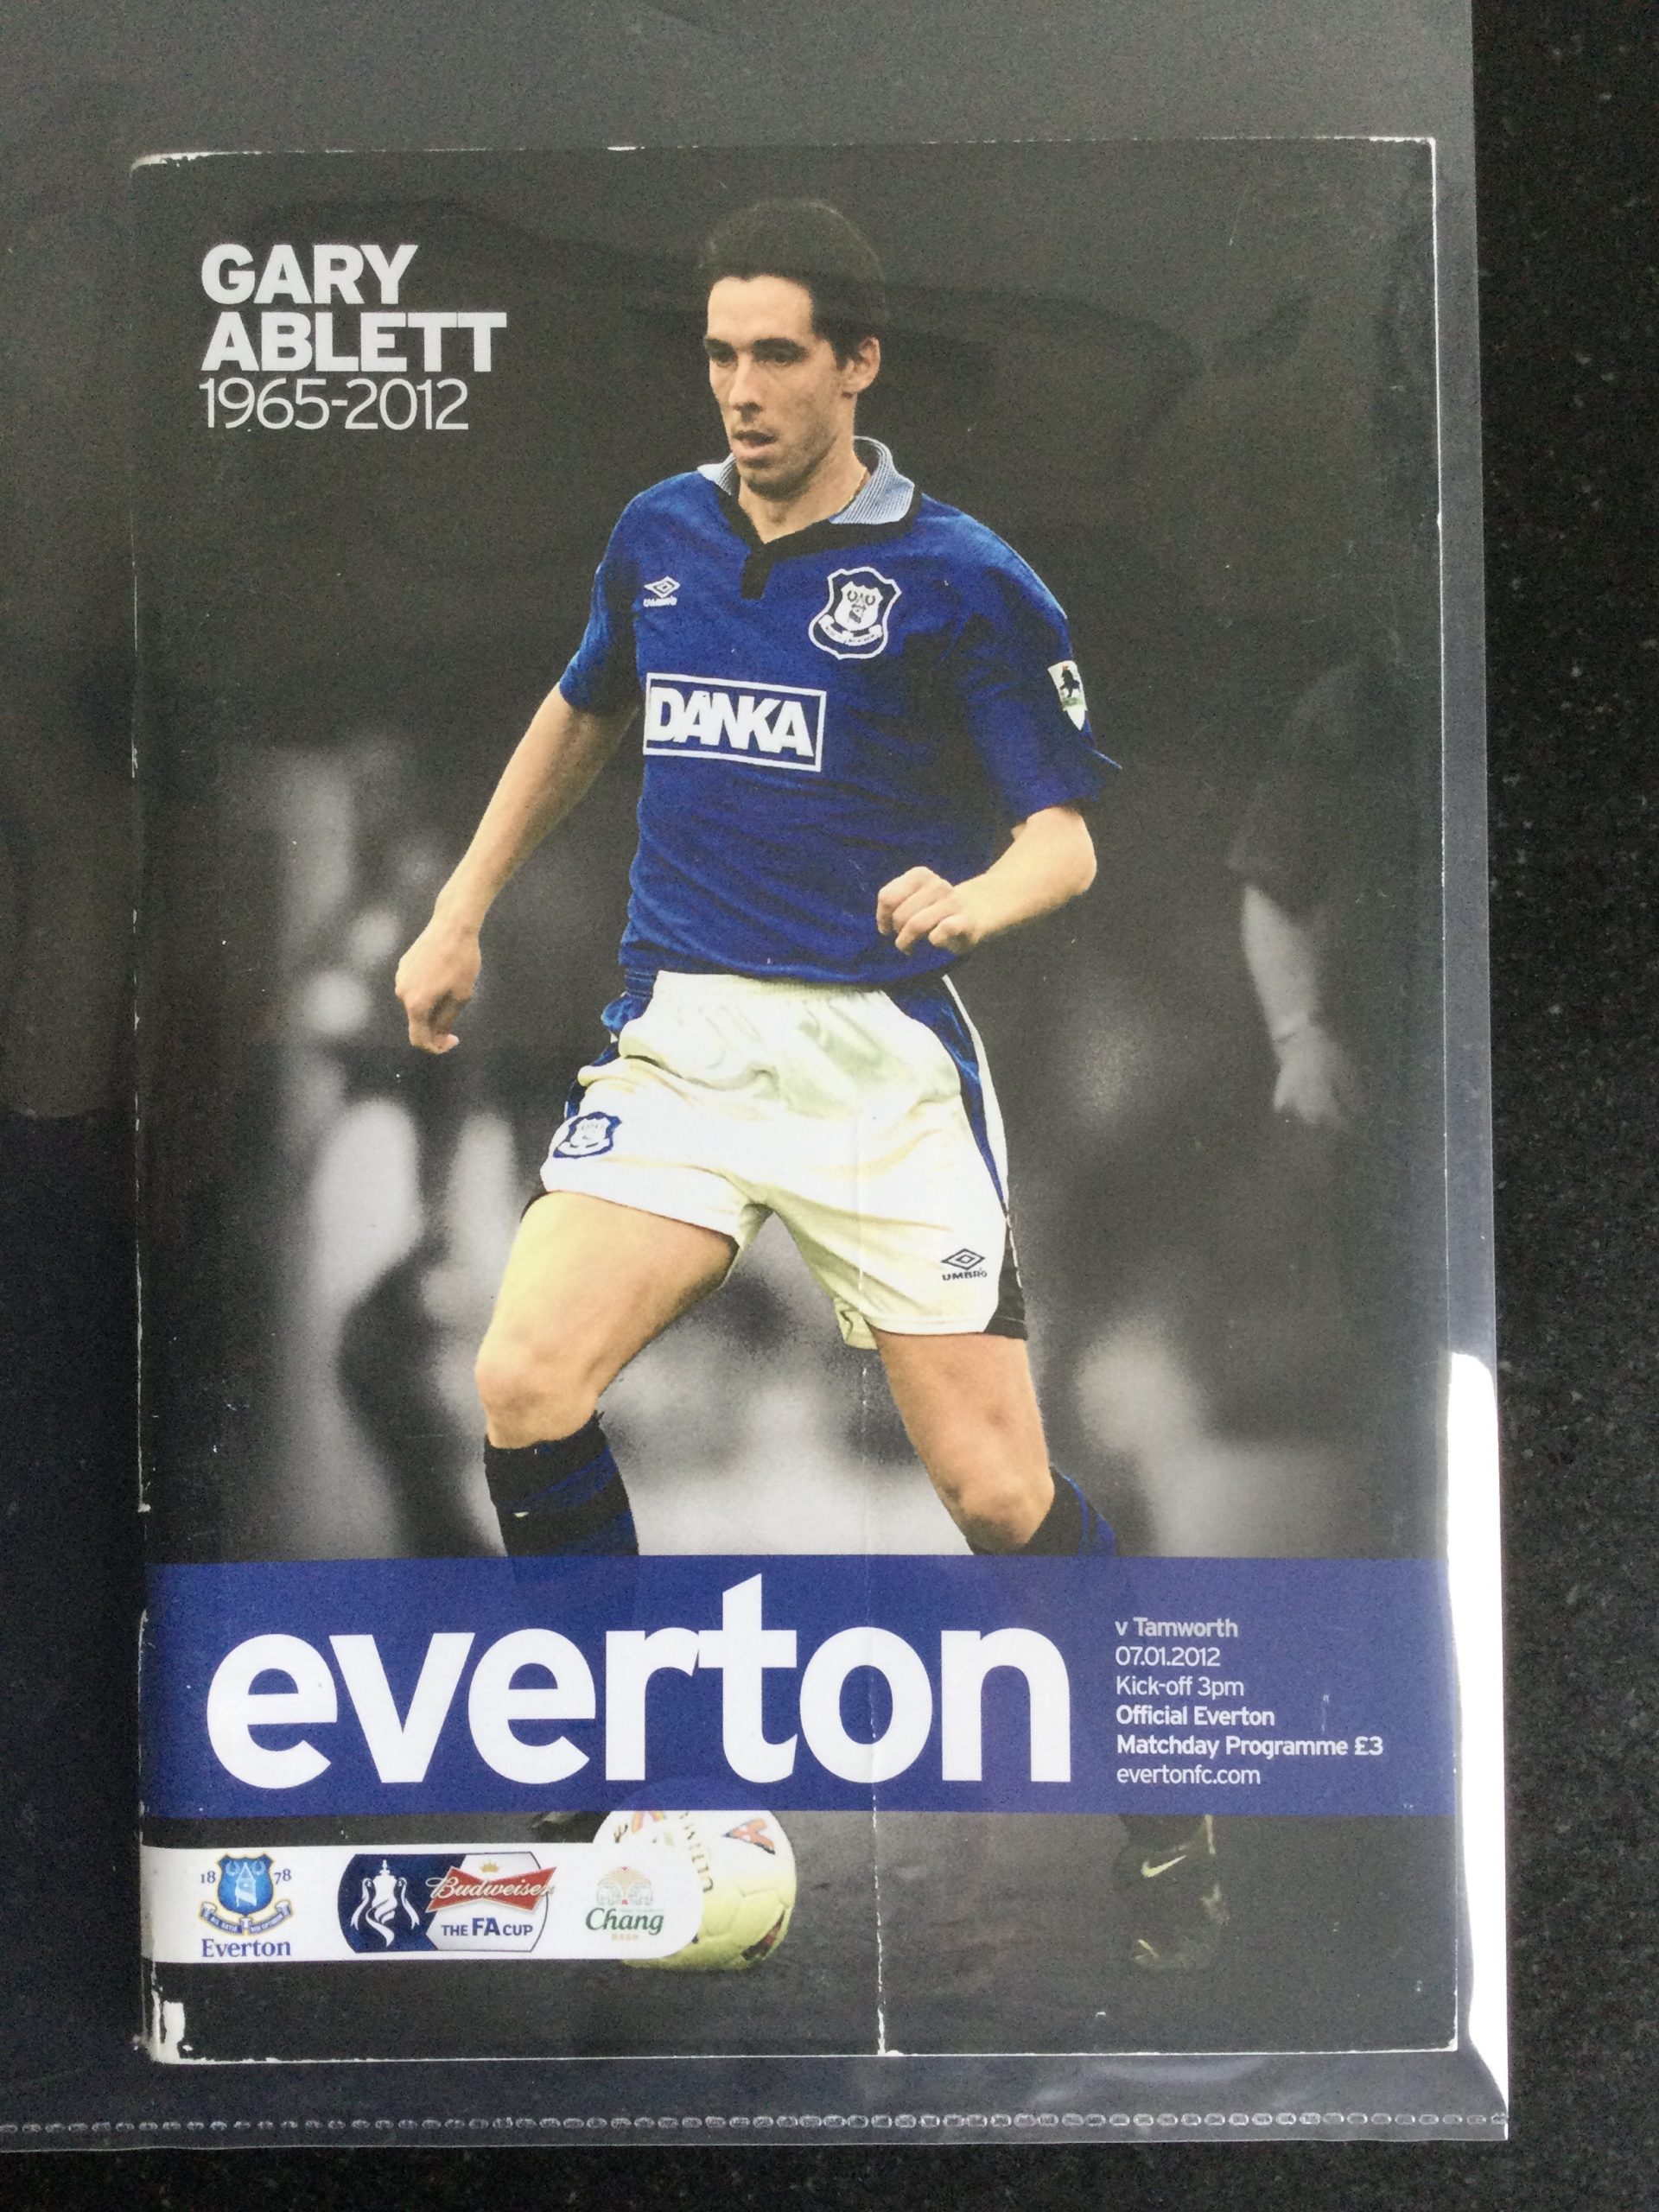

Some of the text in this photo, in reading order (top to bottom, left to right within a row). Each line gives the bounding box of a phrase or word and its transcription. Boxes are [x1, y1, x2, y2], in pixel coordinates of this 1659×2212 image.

[201, 244, 419, 305] GARY
[200, 311, 507, 372] ABLETT
[199, 377, 469, 431] 1965-2012
[649, 686, 815, 757] DANKA
[1115, 1617, 1238, 1637] v Tamworth
[1115, 1646, 1221, 1667] 07.01.2012
[207, 1573, 1071, 1789] everton
[1116, 1675, 1244, 1700] Kick-off 3pm
[1116, 1705, 1275, 1726] Official Everton
[1116, 1735, 1384, 1760] Matchday Programme £3
[1116, 1764, 1261, 1784] evertonfc.com
[200, 1871, 216, 1884] 18
[274, 1868, 292, 1885] 78
[425, 1877, 556, 1899] Budweiser
[442, 1917, 533, 1936] THE FA CUP
[585, 1907, 664, 1936] Chang
[201, 1938, 291, 1957] Everton
